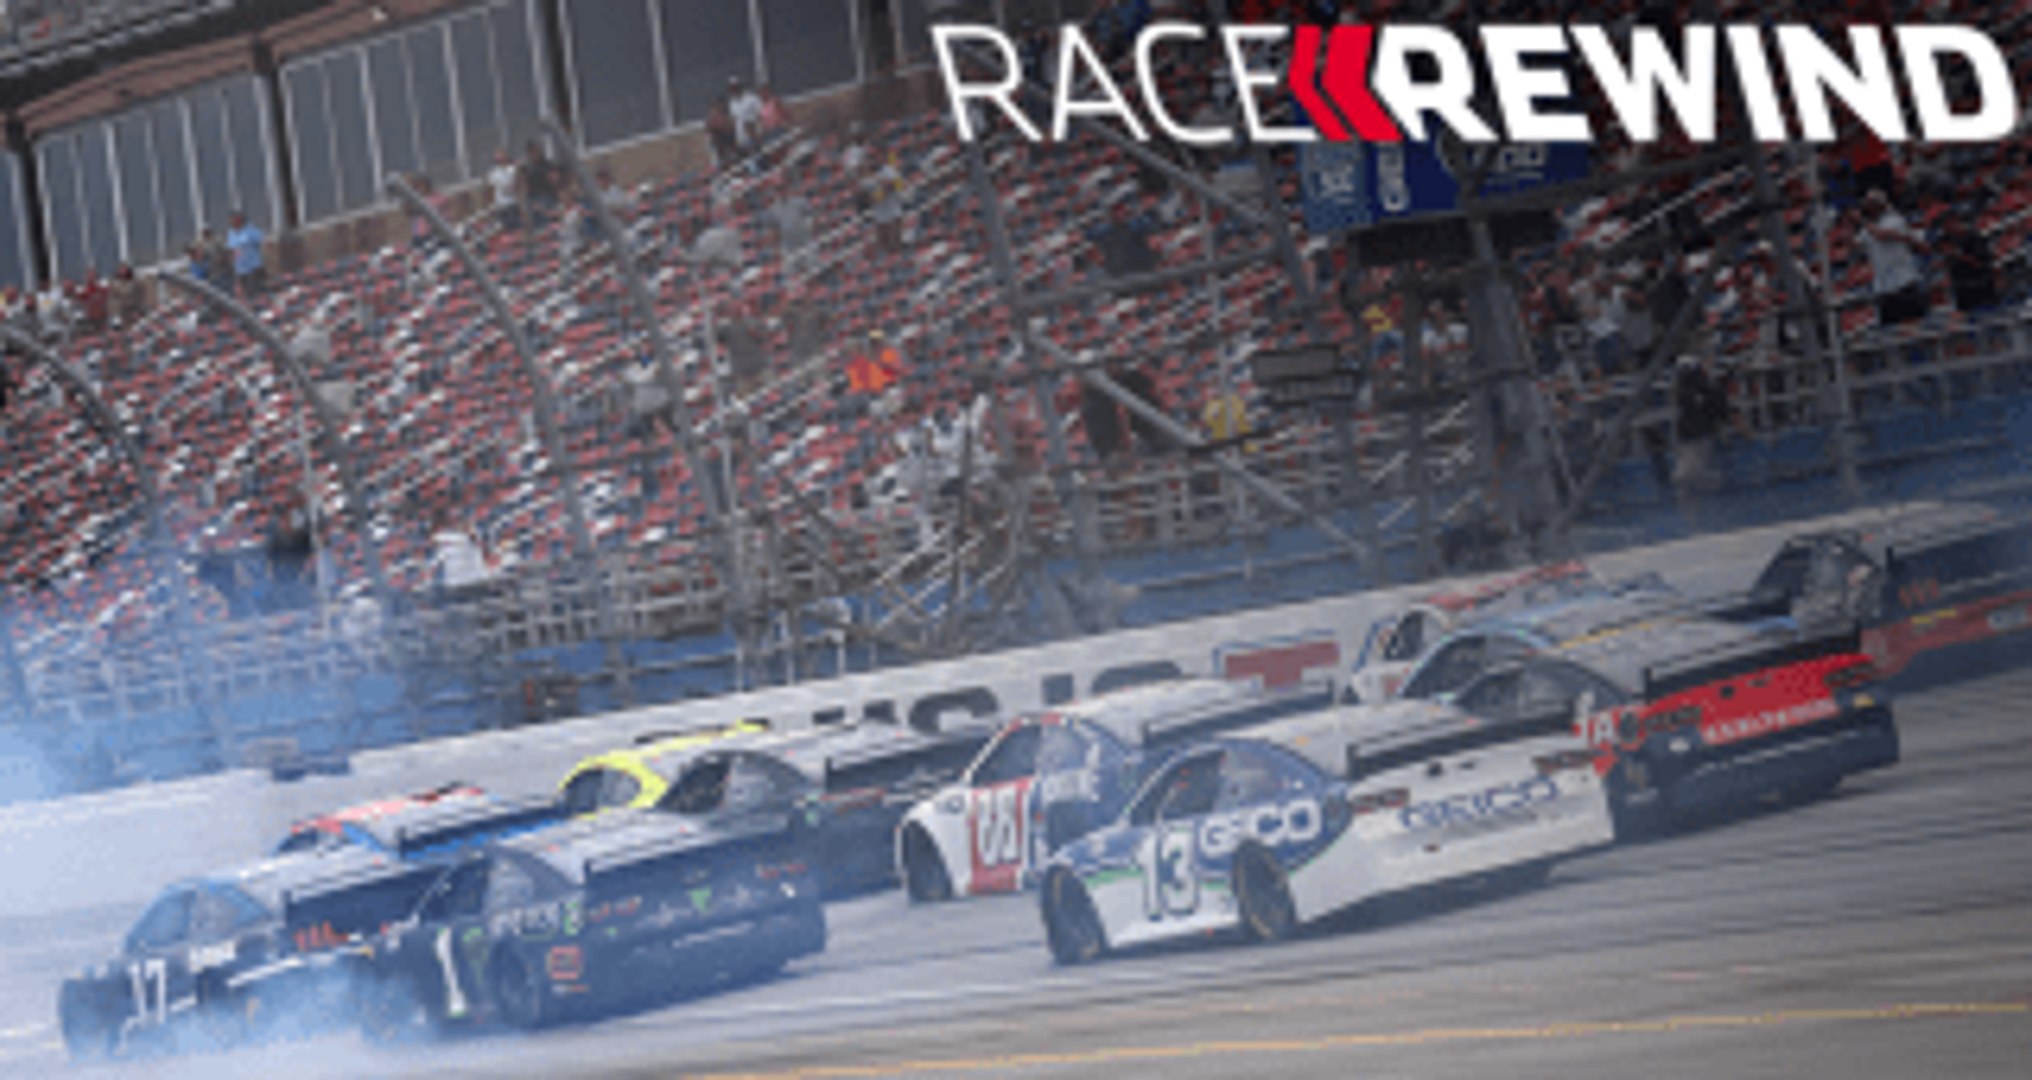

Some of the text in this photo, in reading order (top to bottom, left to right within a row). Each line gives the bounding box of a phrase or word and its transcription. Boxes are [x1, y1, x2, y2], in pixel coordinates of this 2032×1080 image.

[1138, 822, 1198, 920] 13
[127, 958, 166, 1025] 17
[436, 927, 467, 1017] 1
